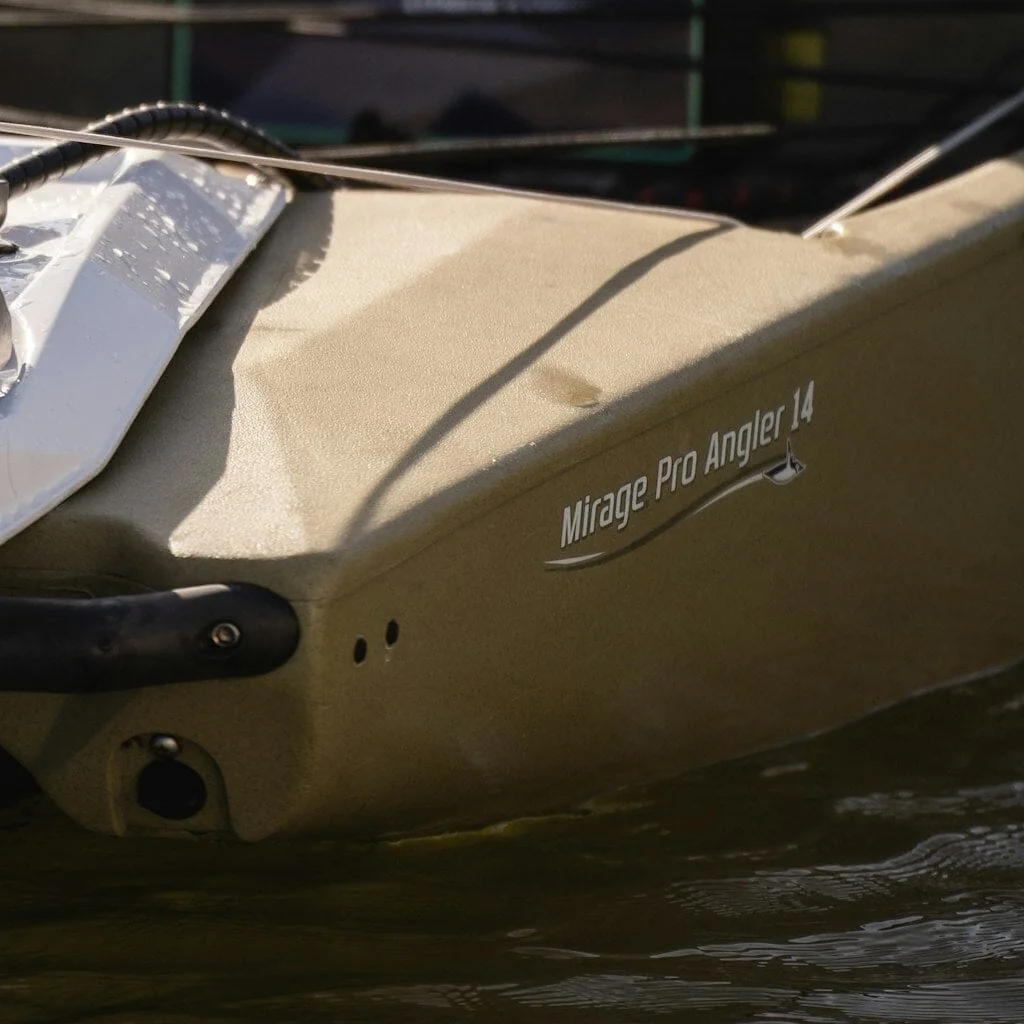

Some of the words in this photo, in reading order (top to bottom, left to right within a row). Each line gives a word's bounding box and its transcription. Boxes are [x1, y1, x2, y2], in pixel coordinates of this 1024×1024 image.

[560, 475, 648, 548] Mirage
[655, 451, 697, 499] Pro
[704, 405, 786, 475] Angler
[791, 380, 815, 431] 14
